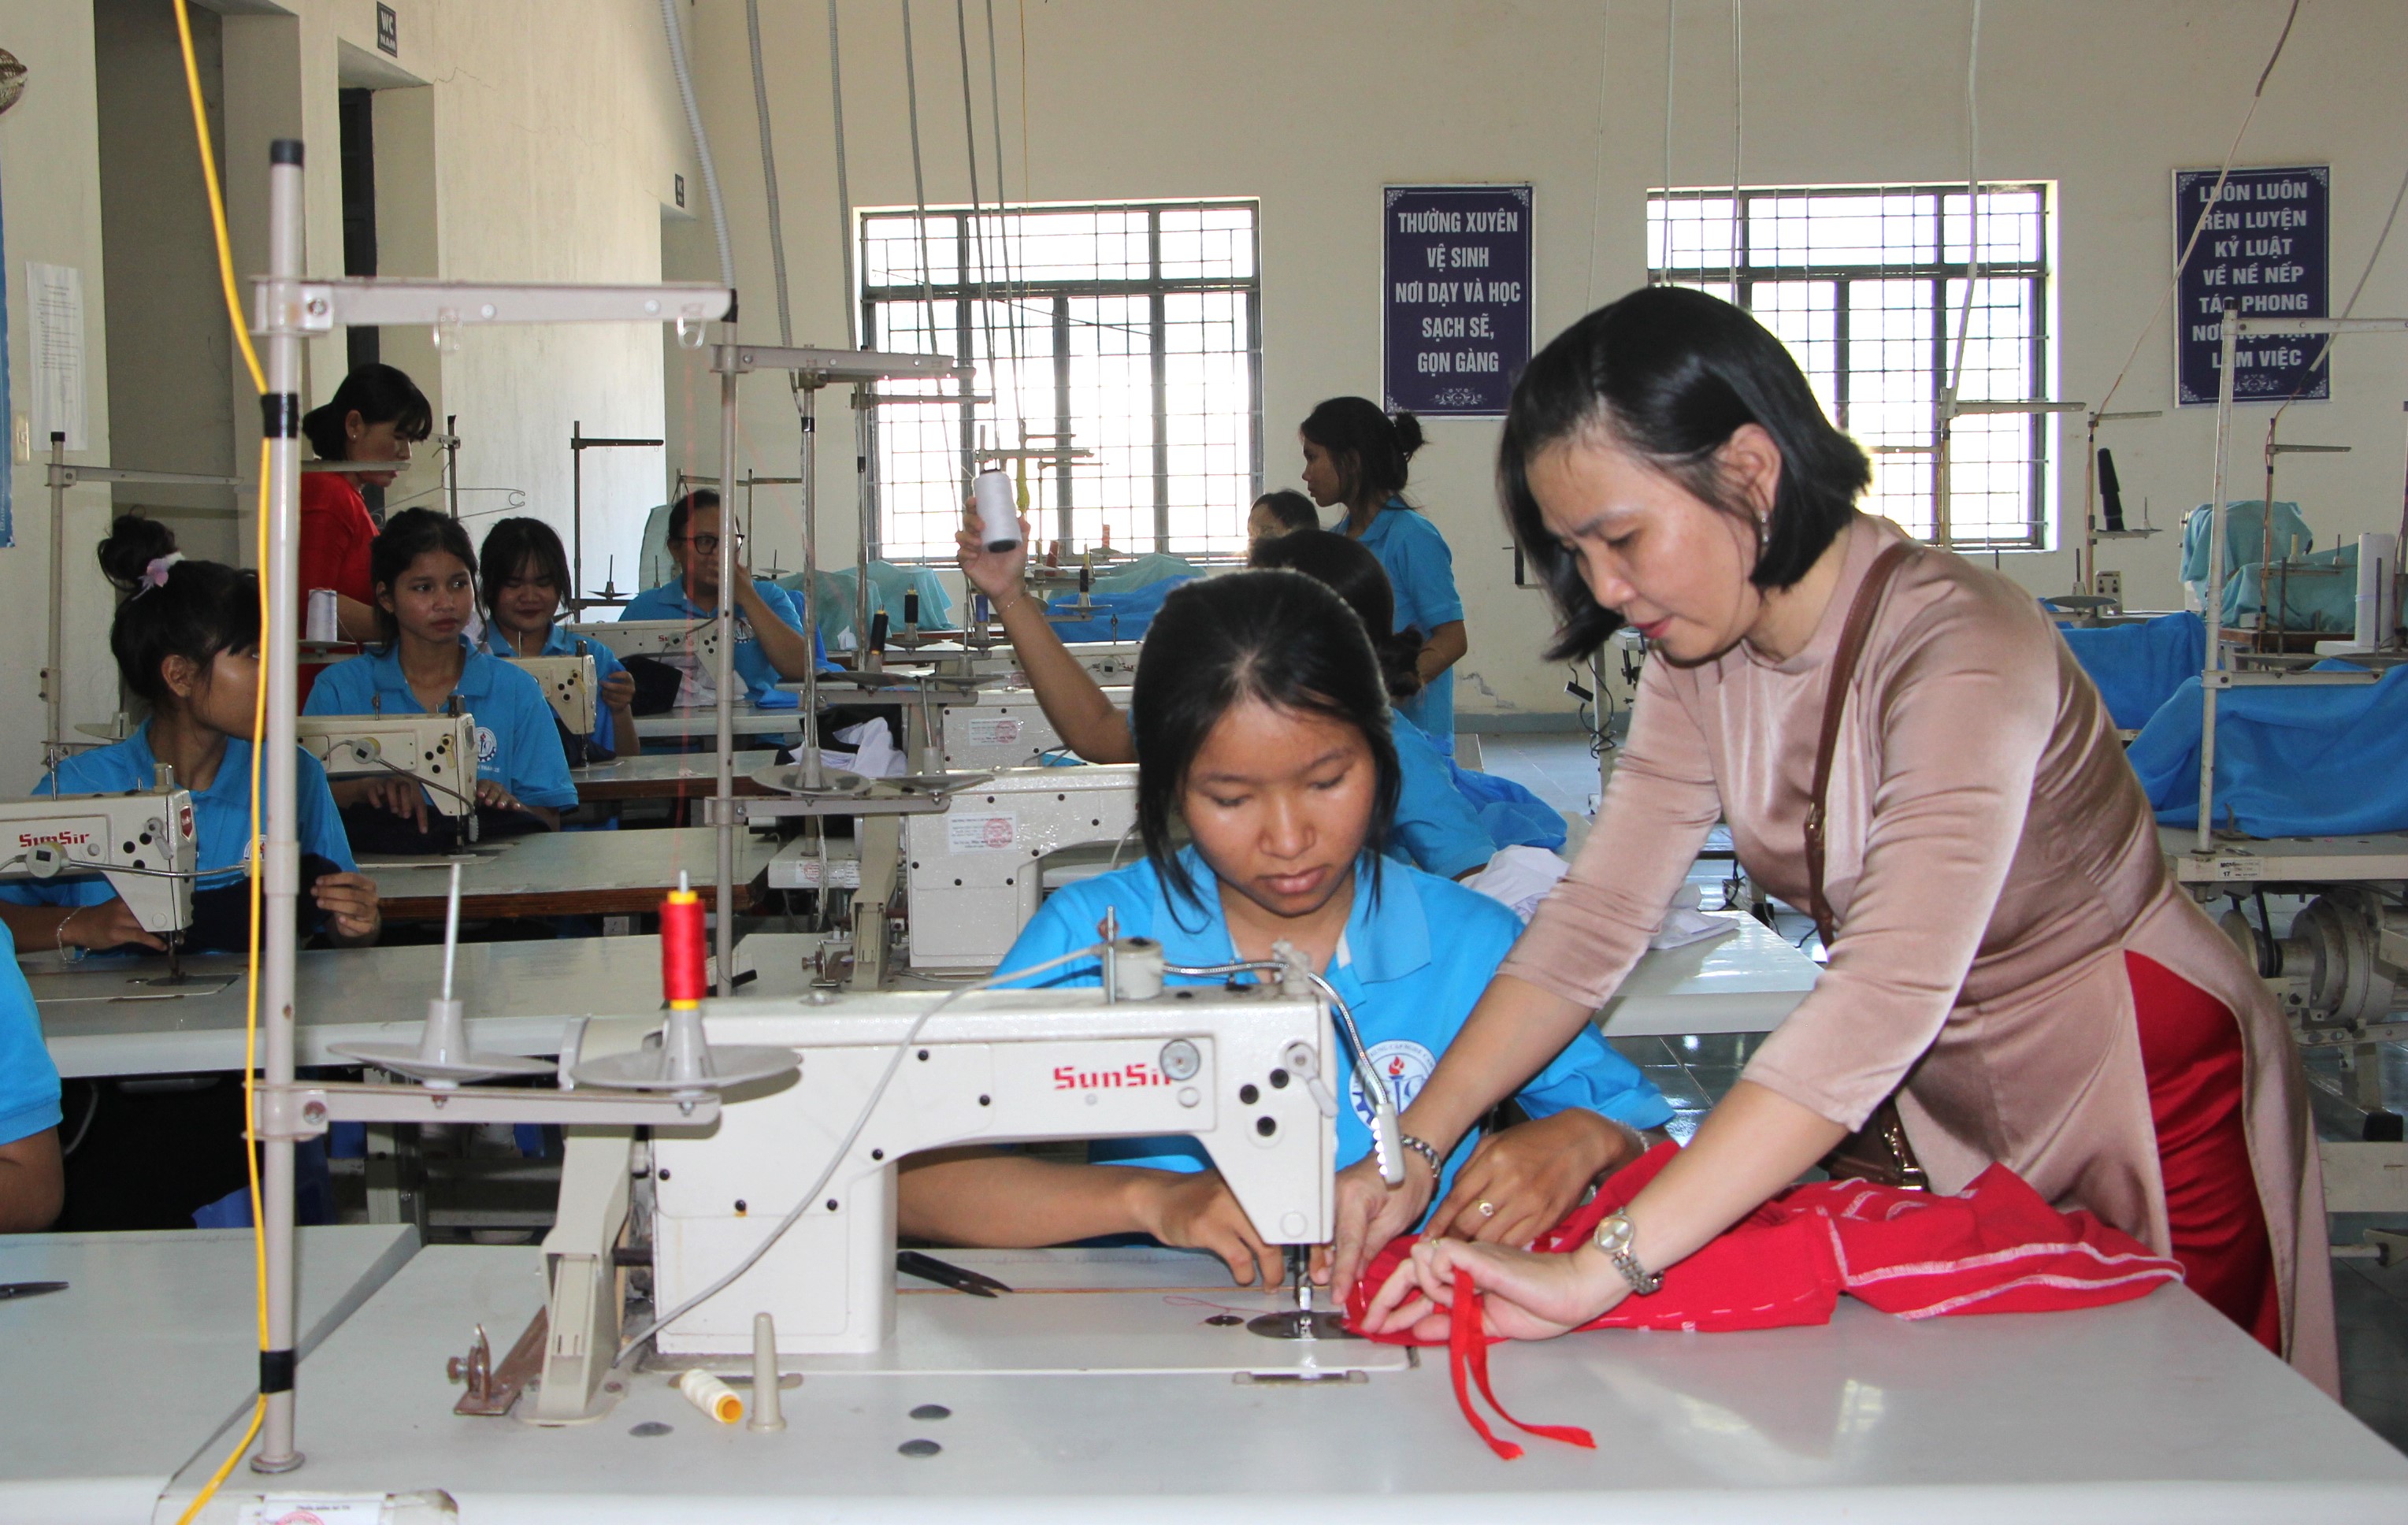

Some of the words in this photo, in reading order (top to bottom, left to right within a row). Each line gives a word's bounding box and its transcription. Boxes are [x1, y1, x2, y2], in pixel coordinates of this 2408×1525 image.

[380, 10, 394, 36] WC
[380, 33, 396, 51] NAM
[2256, 179, 2308, 200] LUÔN
[1398, 207, 1461, 233] THƯỜNG
[1466, 207, 1518, 233] XUYÊN
[2245, 207, 2307, 231] LUYỆN
[1427, 243, 1445, 273] VỆ
[1451, 247, 1490, 268] SINH
[2214, 235, 2239, 258] KỶ
[2245, 235, 2293, 259] LUẬT
[2265, 261, 2304, 284] NẾP
[1395, 280, 1423, 303] NƠI
[1427, 282, 1459, 307] DẠY
[1464, 277, 1485, 302] VÀ
[1489, 282, 1521, 306] HỌC
[2241, 293, 2308, 313] PHONG
[1422, 317, 1464, 342] SẠCH
[1469, 313, 1495, 340] SẼ,
[2192, 323, 2224, 342] NƠ
[1418, 351, 1450, 377] GỌN
[1456, 347, 1499, 373] GÀNG
[2212, 351, 2254, 369] LM
[2258, 347, 2302, 370] VIỆC
